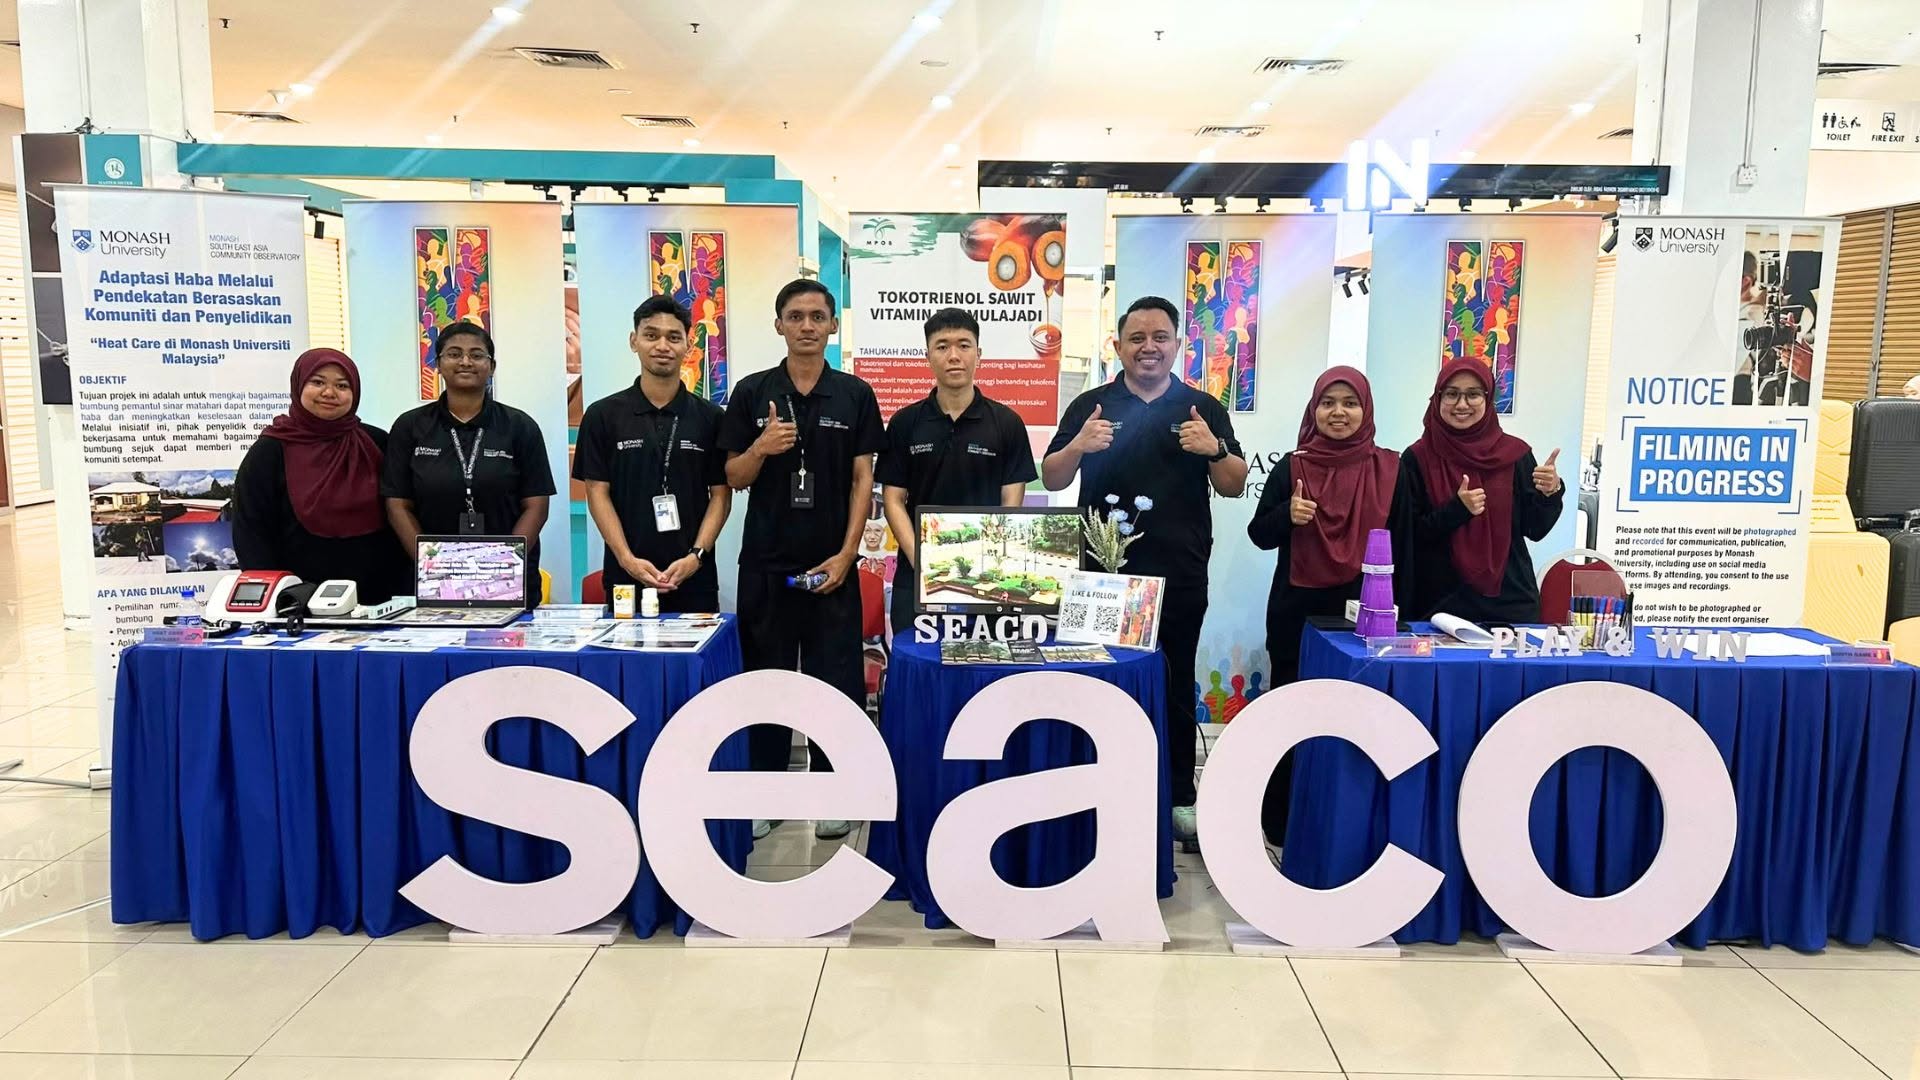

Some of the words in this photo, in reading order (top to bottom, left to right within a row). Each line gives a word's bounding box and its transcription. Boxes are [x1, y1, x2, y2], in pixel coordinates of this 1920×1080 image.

[100, 230, 170, 244] MONASH
[1660, 228, 1724, 240] MONASH
[101, 244, 166, 259] University
[1660, 241, 1719, 255] University
[100, 271, 170, 286] Adaptasi
[175, 272, 213, 286] Haba
[219, 274, 273, 287] Melalui
[94, 289, 187, 304] Pendekatan
[193, 292, 281, 305] Berasaskan
[878, 291, 984, 304] TOKOTRIENOL
[988, 293, 1035, 304] SAWIT
[85, 308, 156, 322] Komuniti
[162, 310, 190, 322] dan
[196, 311, 292, 325] Penyelidikan
[871, 308, 931, 321] VITAMIN
[131, 338, 161, 349] Care
[165, 338, 176, 349] di
[180, 338, 229, 349] Monash
[233, 340, 290, 350] Universiti
[860, 348, 898, 356] TAHUKAH
[80, 376, 127, 384] OBJEKTIF
[1627, 378, 1726, 404] NOTICE
[80, 392, 107, 401] Tujuan
[110, 392, 136, 400] projek
[210, 392, 245, 400] mengkaji
[80, 402, 118, 411] bumbung
[122, 402, 160, 411] pemantul
[186, 402, 222, 410] matahari
[224, 402, 246, 411] dapat
[132, 413, 190, 422] meningkatkan
[119, 423, 149, 431] inisiatif
[157, 423, 170, 432] ini,
[177, 423, 199, 432] pihak
[206, 423, 246, 432] penyelidik
[83, 434, 135, 443] bekerjasama
[84, 445, 122, 454] bumbung
[132, 445, 154, 453] sejuk
[164, 444, 186, 453] dapat
[1639, 435, 1750, 461] FILMING
[1761, 437, 1789, 462] IN
[123, 455, 163, 464] setempat.
[1639, 469, 1784, 496] PROGRESS
[1616, 526, 1641, 534] Please
[1744, 528, 1796, 536] photographed
[1679, 538, 1738, 547] communication,
[1741, 539, 1786, 547] publication,
[1631, 549, 1675, 557] promotional
[1656, 560, 1690, 569] including
[1653, 571, 1662, 579] By
[1664, 572, 1703, 580] attending,
[1644, 582, 1670, 591] images
[1689, 583, 1730, 591] recordings.
[98, 589, 117, 598] APA
[121, 588, 147, 597] YANG
[1092, 591, 1118, 599] FOLLOW
[115, 603, 153, 612] Pemilihan
[1700, 605, 1750, 613] photographed
[116, 614, 153, 624] bumbung
[1674, 616, 1695, 624] notify
[1733, 616, 1769, 625] organiser
[914, 615, 1047, 643] SEACO
[1489, 626, 1588, 658] PLAY
[1605, 626, 1631, 656] &
[1652, 627, 1750, 662] WIN
[398, 667, 1737, 955] seaco
